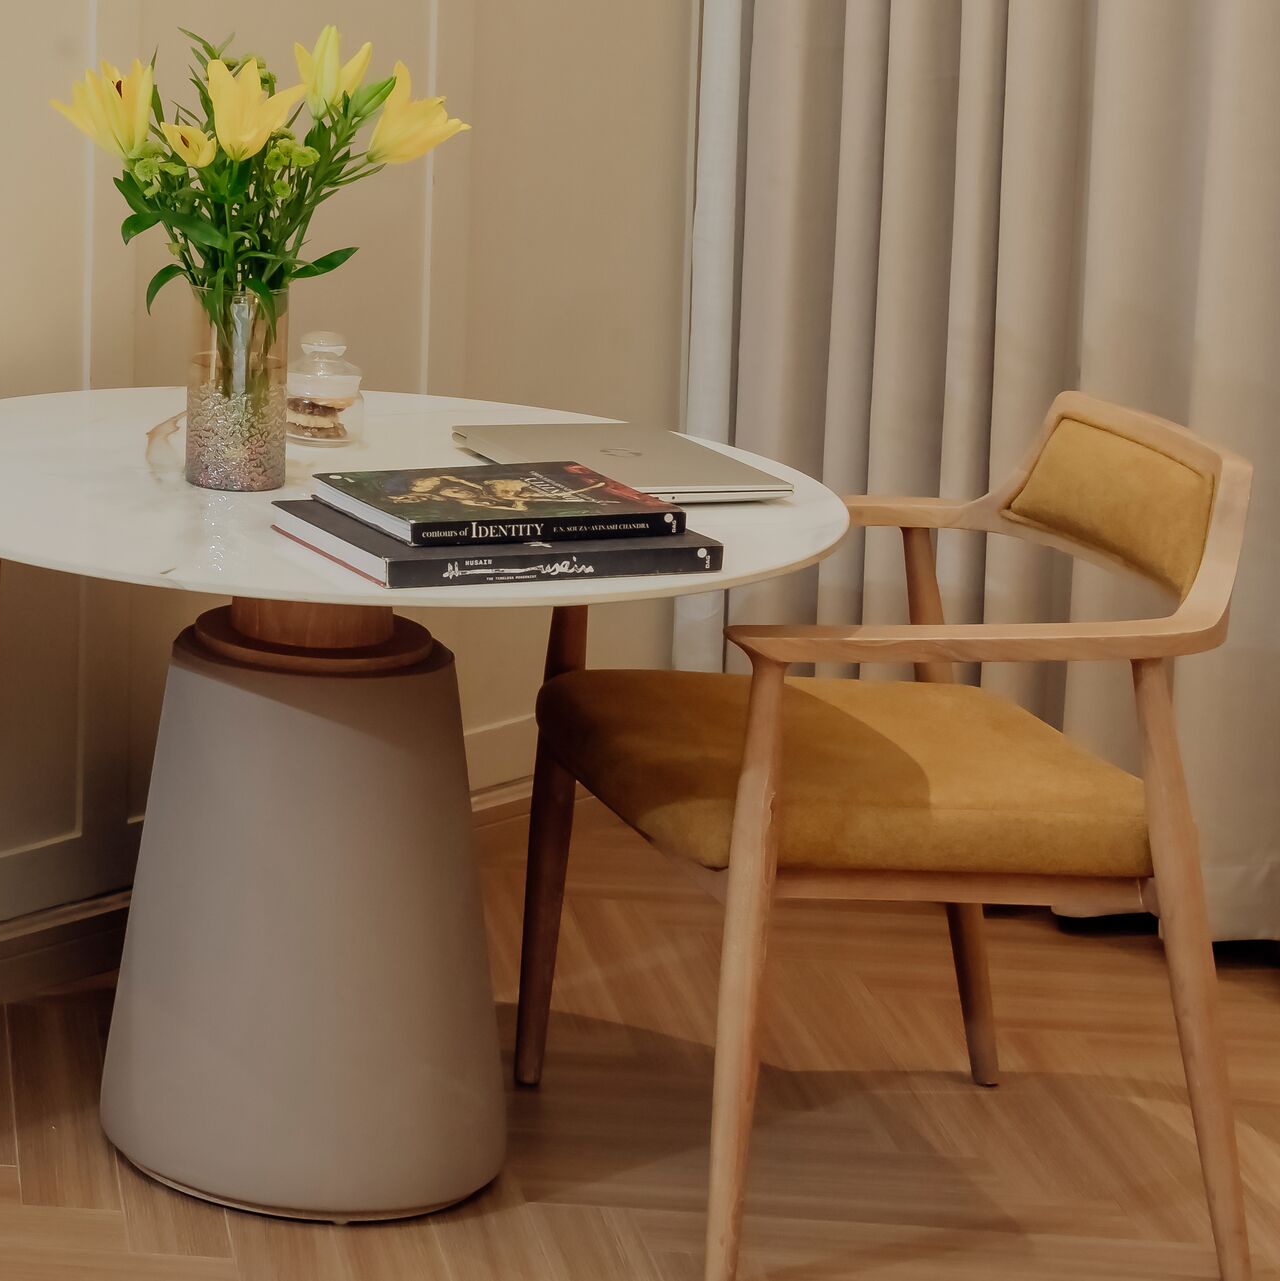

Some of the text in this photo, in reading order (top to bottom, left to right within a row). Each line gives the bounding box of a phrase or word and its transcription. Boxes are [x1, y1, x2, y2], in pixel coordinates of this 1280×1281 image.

[421, 521, 545, 539] contours of IDENTITY
